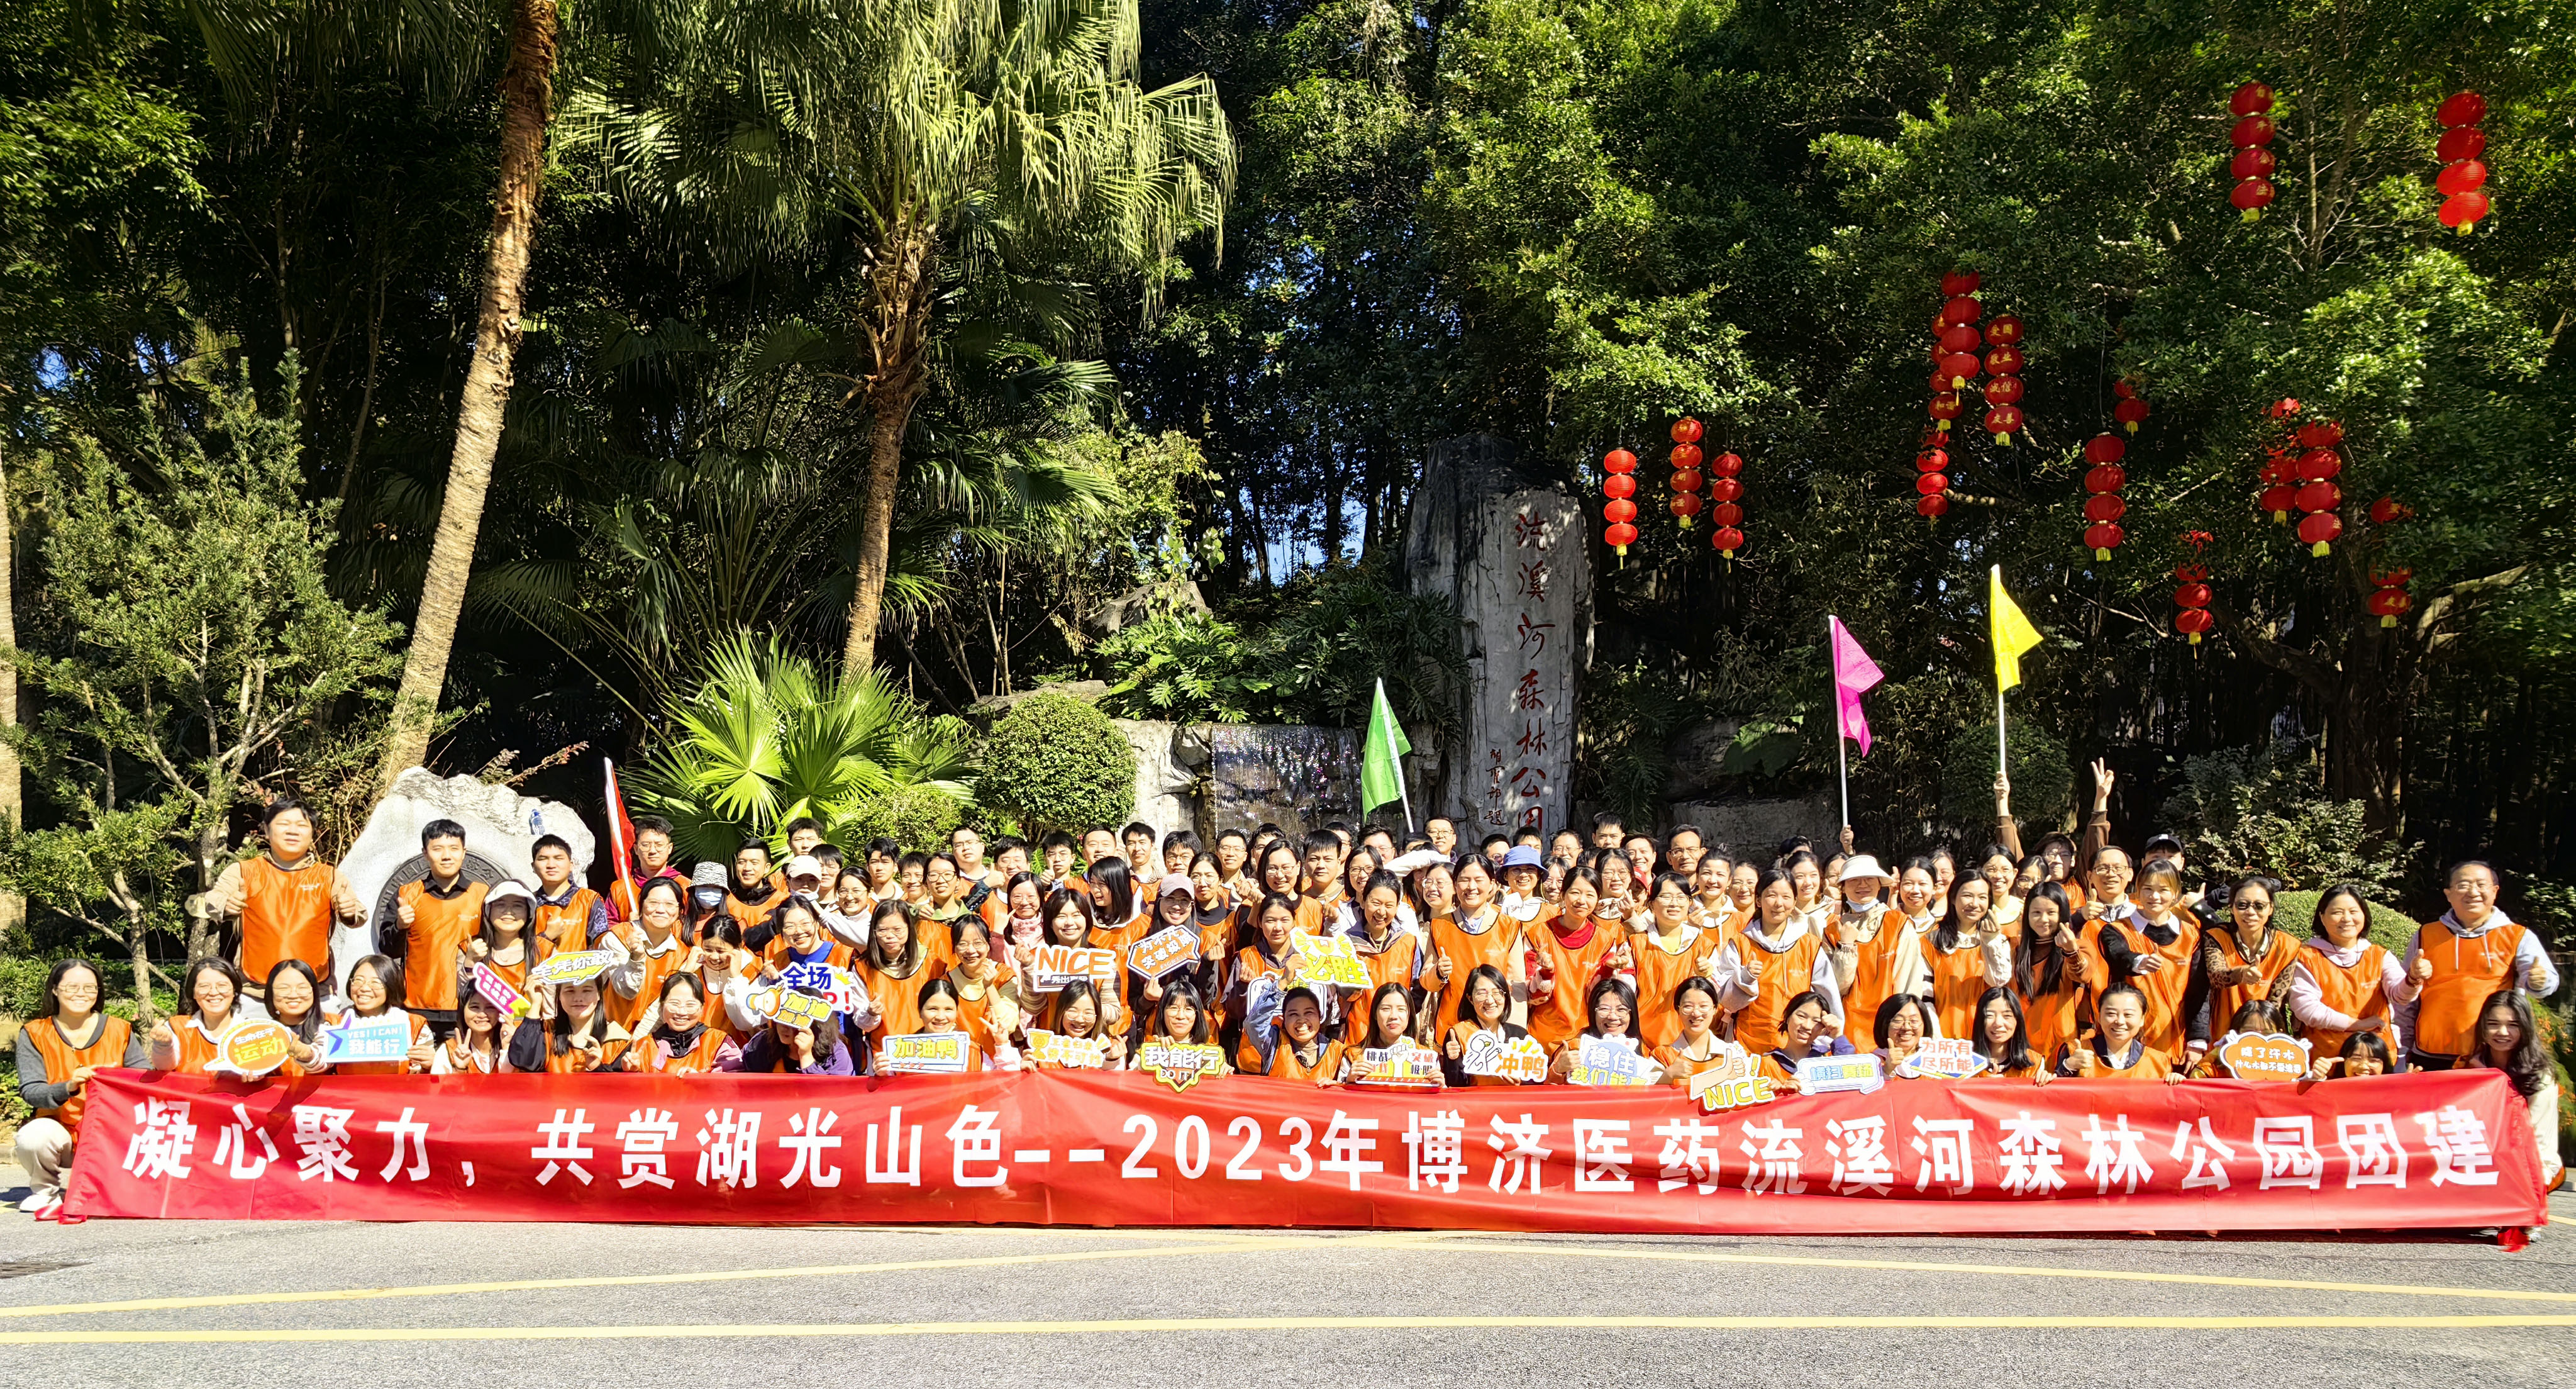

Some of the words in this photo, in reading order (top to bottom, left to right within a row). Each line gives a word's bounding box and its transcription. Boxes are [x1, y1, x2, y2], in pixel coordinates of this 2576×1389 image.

[1038, 948, 1113, 974] NICE
[1302, 952, 1368, 985] 必胜
[783, 966, 831, 990] 全场
[781, 993, 831, 1019] 加油
[234, 1027, 275, 1044] 生命在于
[348, 1038, 401, 1055] 我能行
[1922, 1040, 1970, 1054] 为所有
[234, 1037, 288, 1066] 运动
[893, 1037, 958, 1060] 加油鸭
[1145, 1046, 1219, 1070] 我能行
[1411, 1052, 1434, 1063] 突破
[1588, 1045, 1636, 1074] 稳住
[1160, 1069, 1175, 1079] DO
[1495, 1054, 1545, 1079] 冲鸭
[1810, 1063, 1874, 1081] 横扫赛场
[1922, 1057, 1972, 1072] 尽所能
